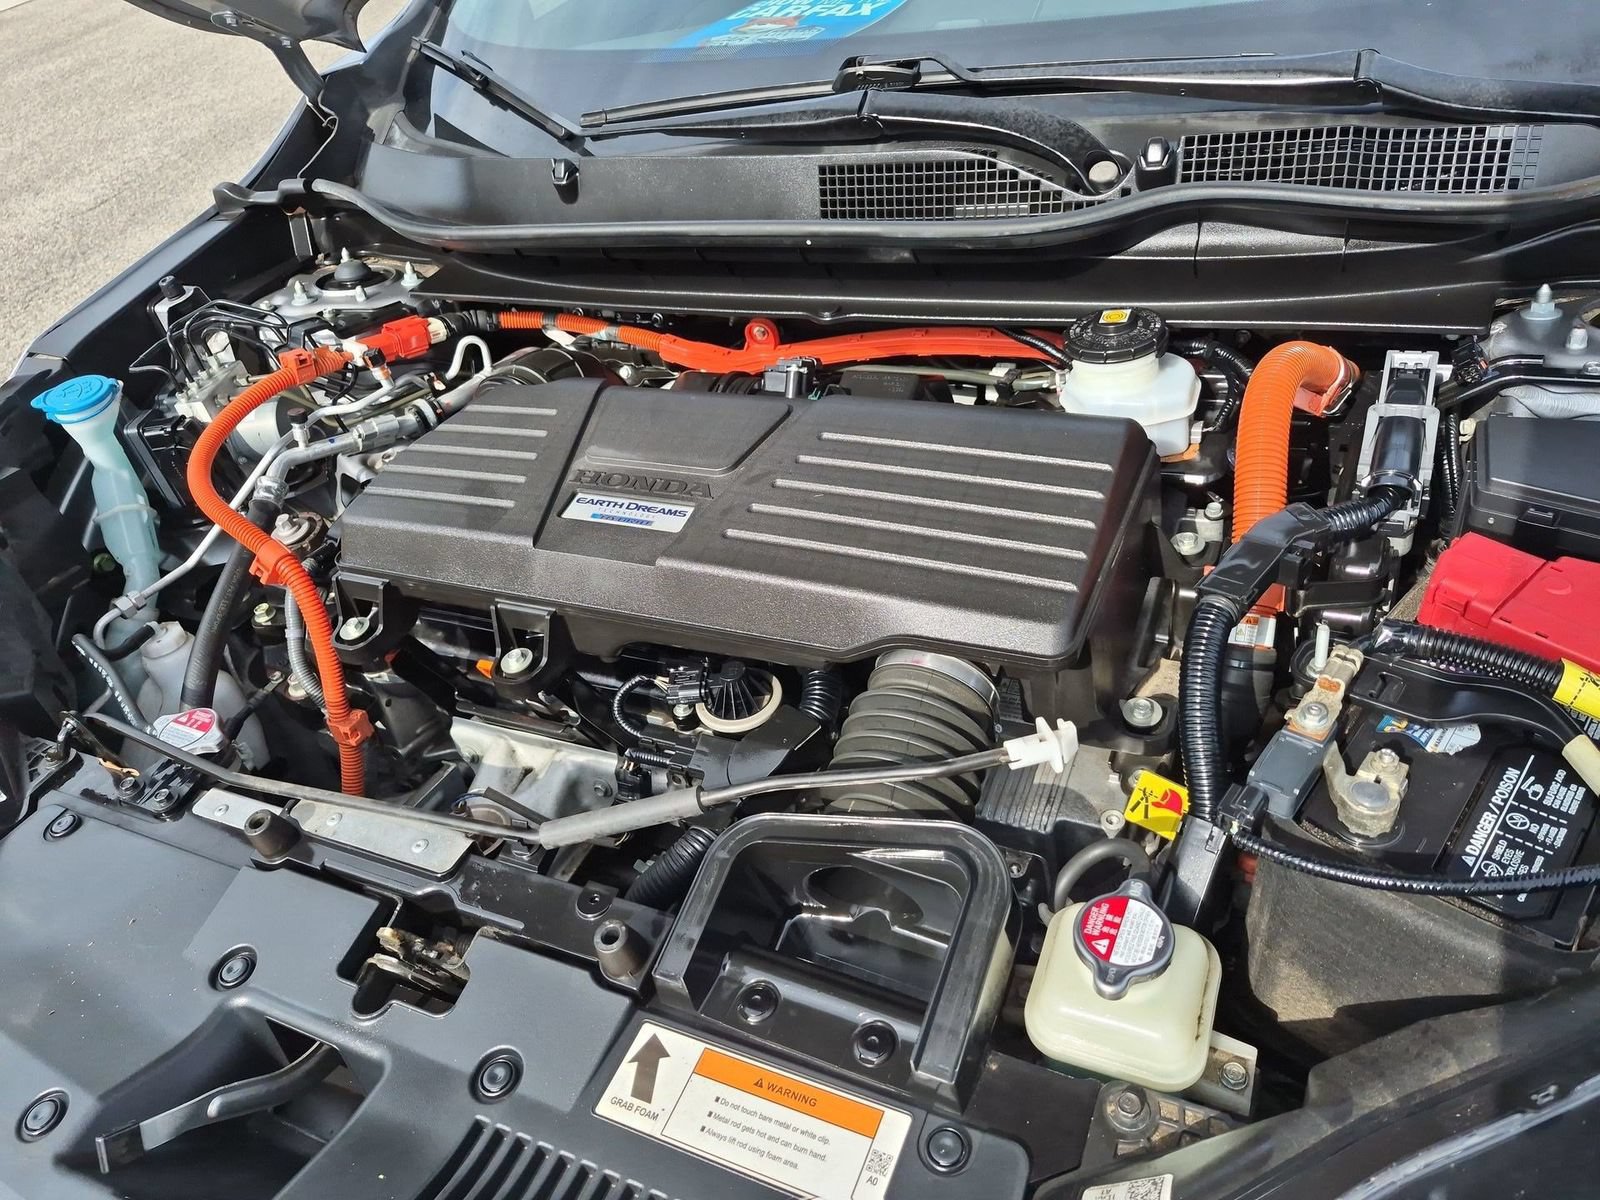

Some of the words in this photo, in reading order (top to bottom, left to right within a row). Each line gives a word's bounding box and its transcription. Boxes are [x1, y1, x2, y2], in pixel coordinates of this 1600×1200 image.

[725, 2, 889, 20] CARFAX
[568, 469, 714, 500] HONDA
[576, 497, 622, 509] EARTH
[1465, 812, 1498, 856] DANGER
[1491, 767, 1520, 806] POISON
[1492, 840, 1508, 860] SHIELD
[1500, 848, 1514, 864] EYES
[1504, 849, 1525, 876] XPLOSIVE
[1084, 906, 1100, 934] DANGER
[1092, 902, 1110, 936] WARNING
[610, 1096, 634, 1111] GRAB
[634, 1106, 659, 1120] FOAM
[768, 1082, 817, 1107] WARNING
[713, 1112, 730, 1124] Metal
[730, 1119, 742, 1129] rod
[741, 1124, 756, 1134] gets
[756, 1128, 767, 1139] hot
[767, 1134, 780, 1144] and
[780, 1140, 792, 1148] can
[793, 1144, 808, 1154] burn
[720, 1098, 730, 1106] Do
[730, 1103, 740, 1111] not
[741, 1106, 758, 1117] touch
[758, 1112, 773, 1124] bare
[774, 1118, 792, 1130] metal
[800, 1129, 816, 1140] white
[817, 1135, 830, 1146] clip.
[705, 1128, 727, 1142] Always
[728, 1136, 736, 1145] lift
[736, 1140, 748, 1150] rod
[748, 1145, 766, 1158] using
[766, 1150, 782, 1163] foam
